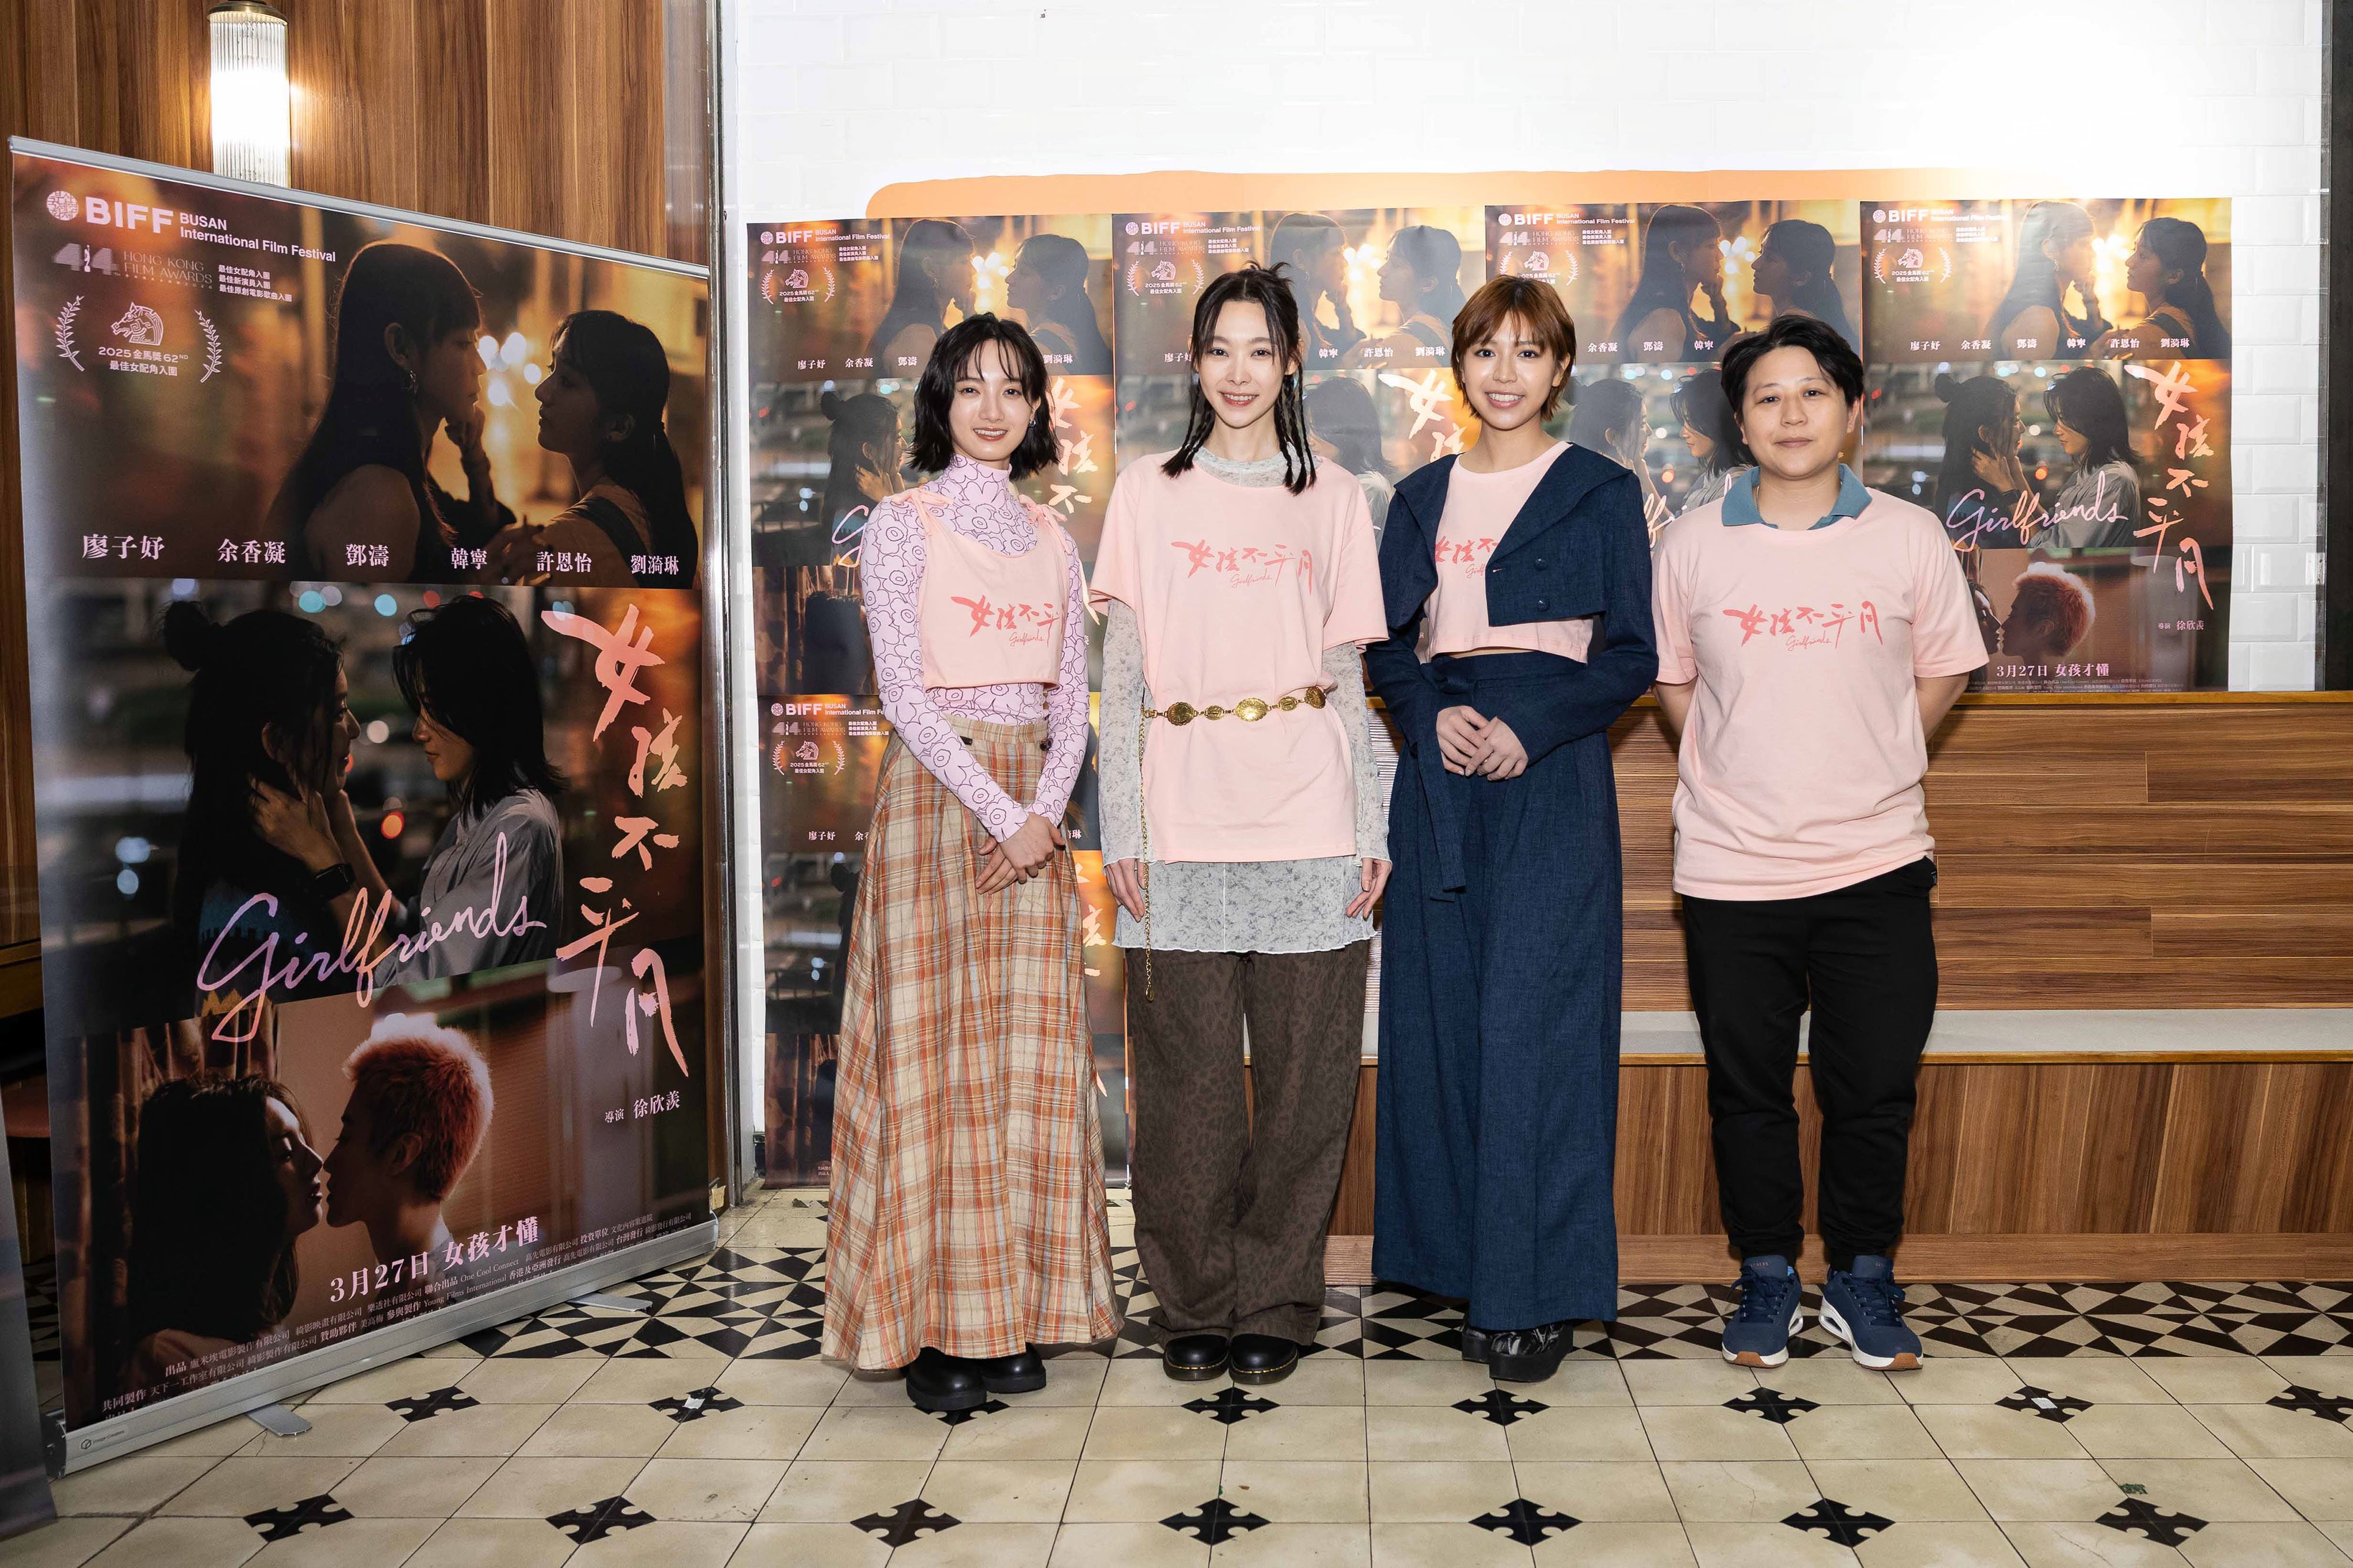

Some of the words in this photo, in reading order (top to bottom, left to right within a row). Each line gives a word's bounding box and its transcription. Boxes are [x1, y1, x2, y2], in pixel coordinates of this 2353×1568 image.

[85, 196, 174, 233] BIFF
[180, 212, 226, 231] BUSAN
[1514, 213, 1554, 225] BIFF
[1888, 209, 1929, 222] BIFF
[776, 230, 812, 243] BIFF
[1141, 222, 1181, 234] BIFF
[181, 226, 259, 249] International
[262, 240, 288, 254] Film
[292, 245, 336, 262] Festival
[124, 251, 162, 265] HONG
[168, 257, 204, 272] KONG
[124, 262, 154, 276] FILM
[161, 267, 212, 284] AWARDS
[218, 265, 270, 280] 最佳女配角入圍
[98, 347, 131, 358] 2025
[109, 361, 178, 376] 最佳女配角入圍
[1946, 470, 2129, 552] Girlfriends
[82, 534, 165, 560] 廖子妤
[218, 539, 286, 564] 余香凝
[345, 543, 389, 567] 鄧濤
[451, 548, 488, 570] 韓寧
[536, 551, 592, 573] 許恩怡
[631, 554, 679, 576] 劉漪琳
[1997, 665, 2048, 678] 3月27日
[2054, 663, 2109, 677] 女孩才懂
[786, 703, 822, 716] BIFF
[197, 831, 546, 1043] Girlfriends
[605, 1108, 624, 1123] 導演
[330, 1250, 428, 1302] 3月27日
[442, 1215, 539, 1272] 女孩才懂
[165, 1361, 186, 1377] 出品
[425, 1276, 458, 1295] 聯合出品
[476, 1266, 491, 1277] Cool
[494, 1259, 519, 1272] Connect
[102, 1389, 146, 1412] 共同製作
[424, 1296, 444, 1307] Young
[447, 1290, 464, 1300] Films
[466, 1275, 506, 1294] International
